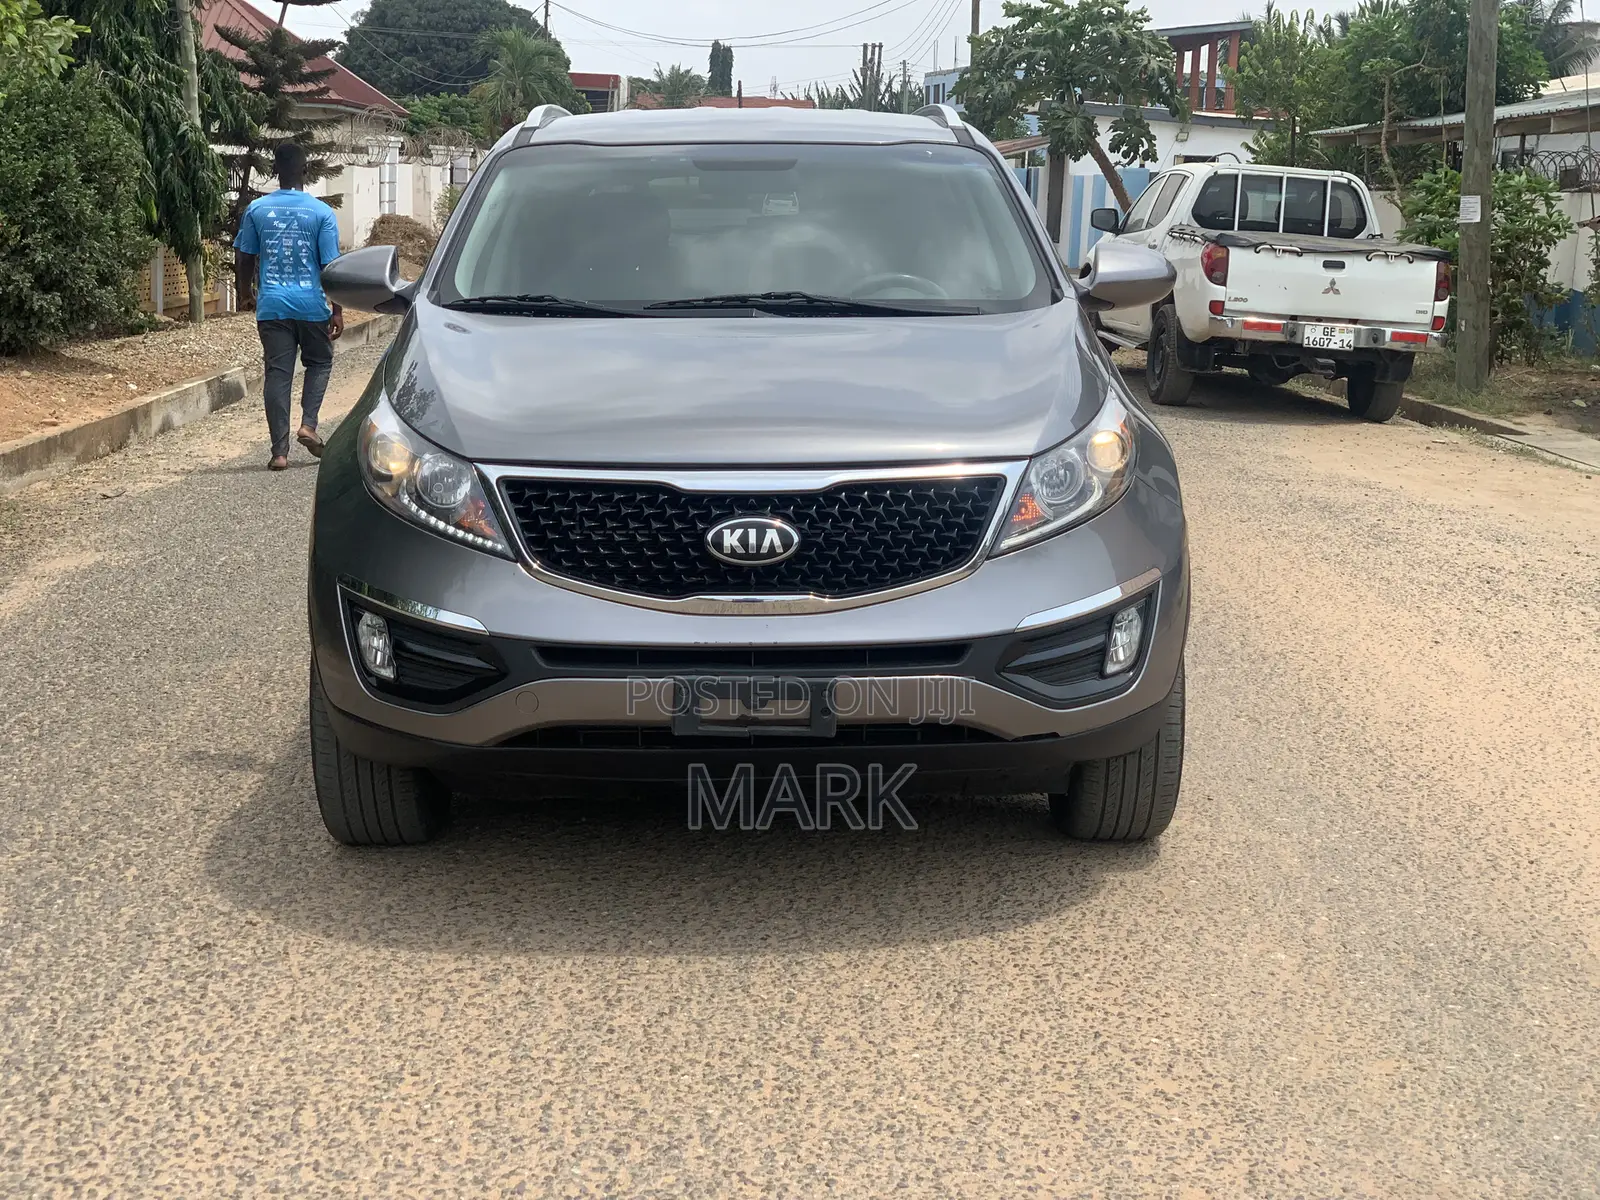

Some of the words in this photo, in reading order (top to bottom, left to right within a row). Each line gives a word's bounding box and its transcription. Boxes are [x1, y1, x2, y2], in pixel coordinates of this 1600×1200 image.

[1323, 327, 1336, 337] GE
[1305, 336, 1352, 349] 1607-14
[722, 528, 784, 553] KIA
